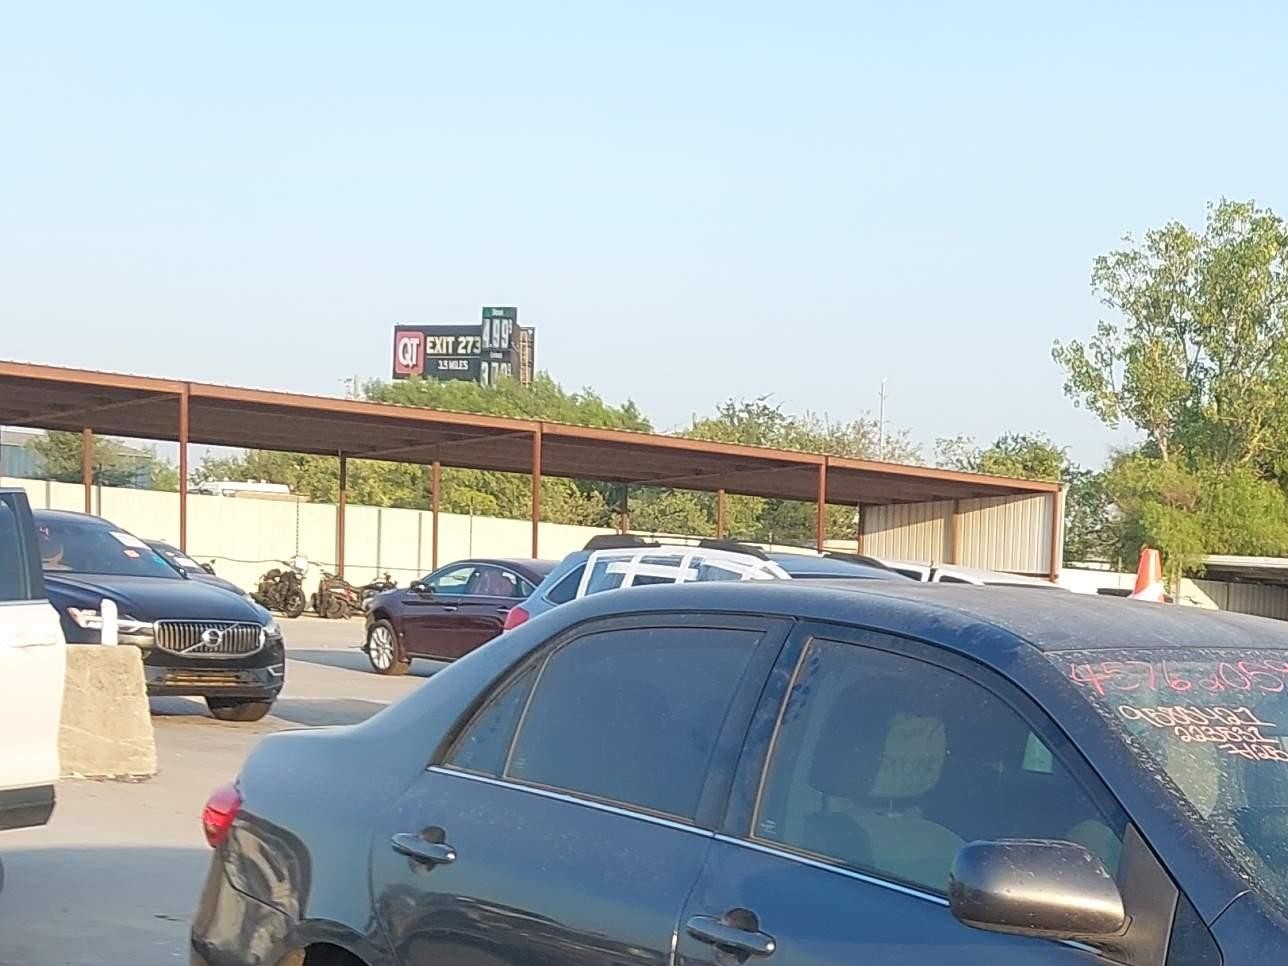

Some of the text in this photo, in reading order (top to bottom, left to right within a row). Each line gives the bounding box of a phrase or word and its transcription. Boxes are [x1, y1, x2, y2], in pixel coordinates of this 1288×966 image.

[399, 337, 420, 368] QT
[426, 336, 482, 354] EXIT 273
